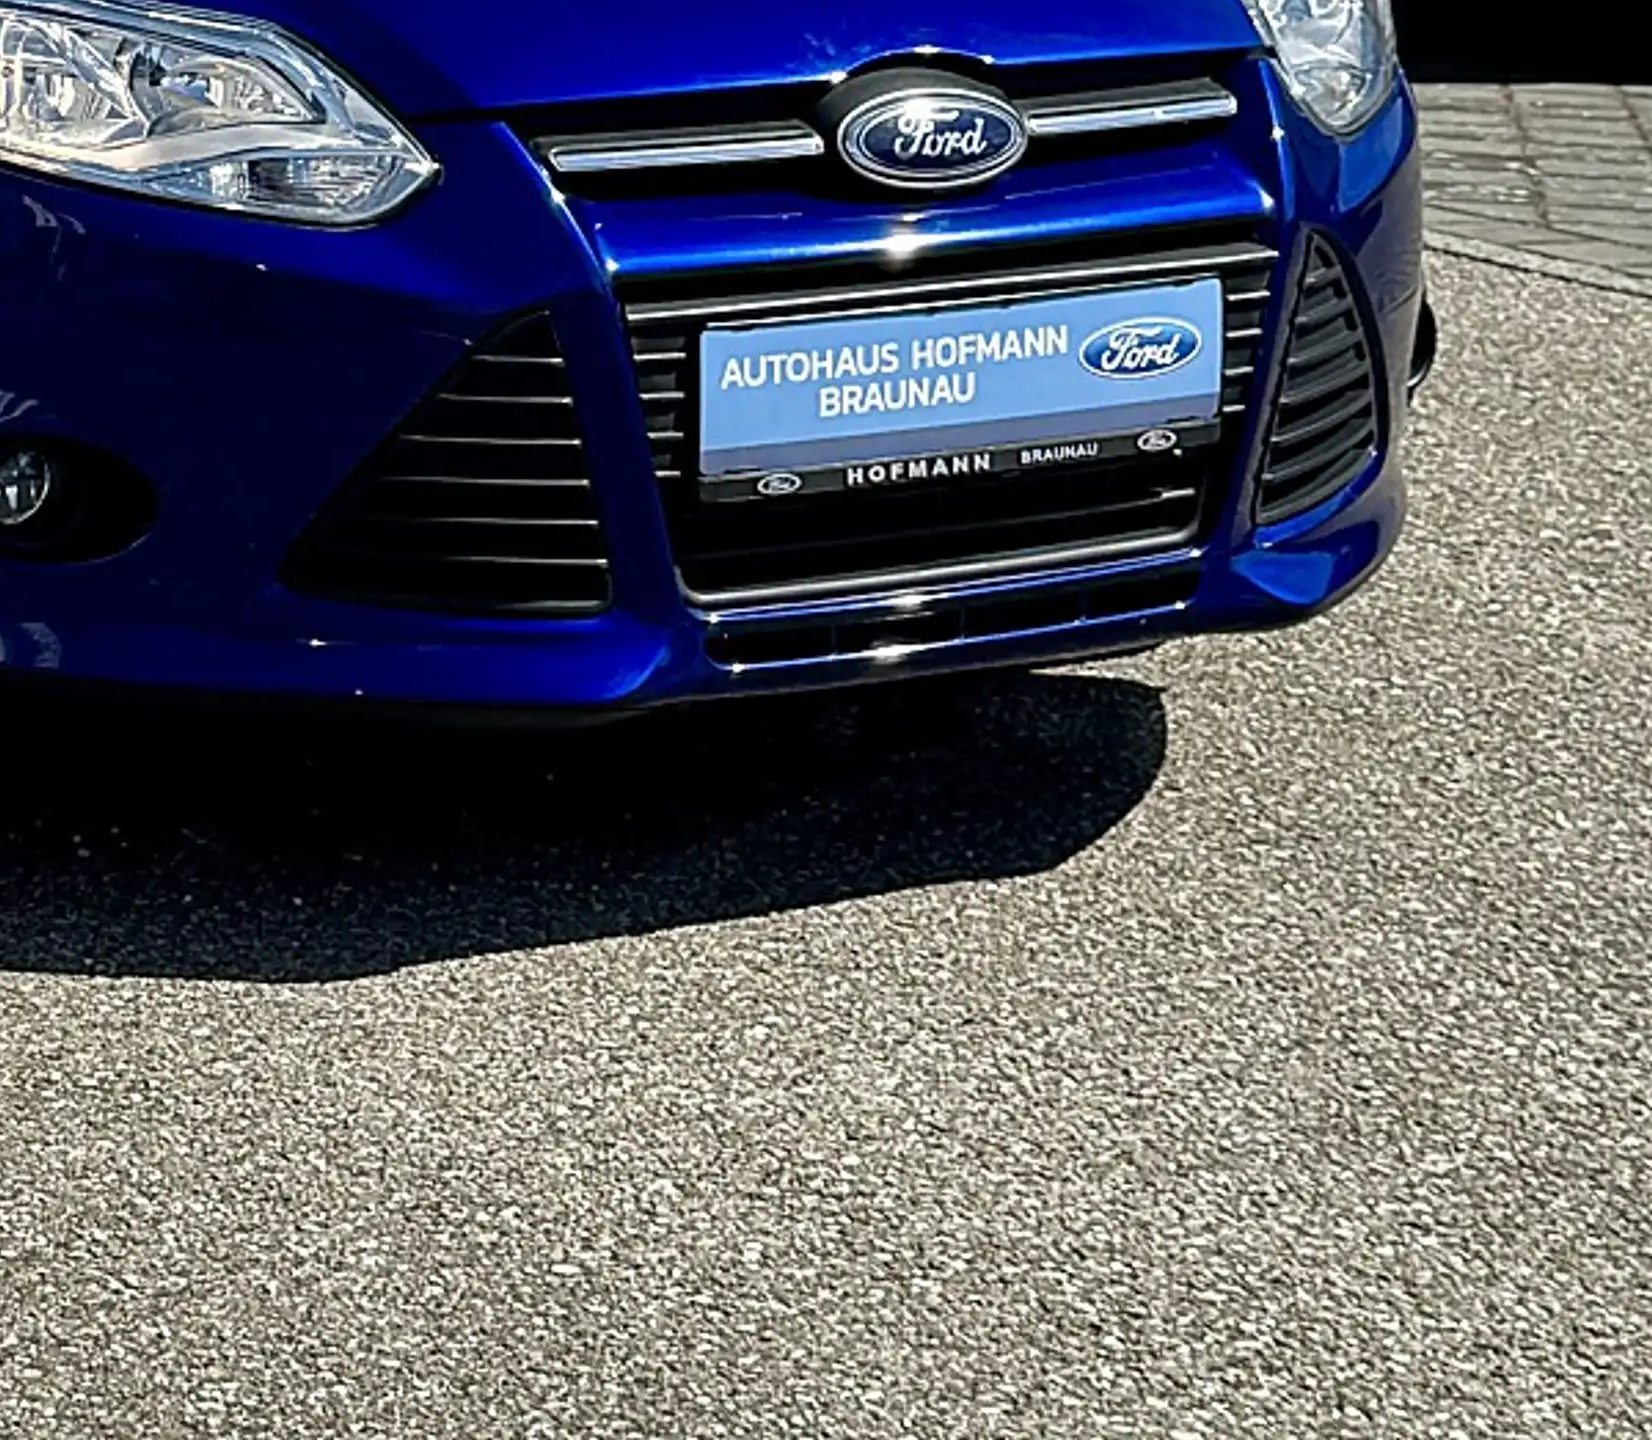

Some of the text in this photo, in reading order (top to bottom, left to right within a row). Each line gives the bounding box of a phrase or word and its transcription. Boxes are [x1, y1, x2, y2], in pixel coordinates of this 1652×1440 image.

[894, 99, 988, 158] Ford
[720, 324, 1069, 390] AUTOHAUS HOFMANN
[1101, 326, 1181, 370] Ford
[819, 371, 977, 418] BRAUNAU
[847, 441, 1100, 486] HOFMANN BRAUNAU
